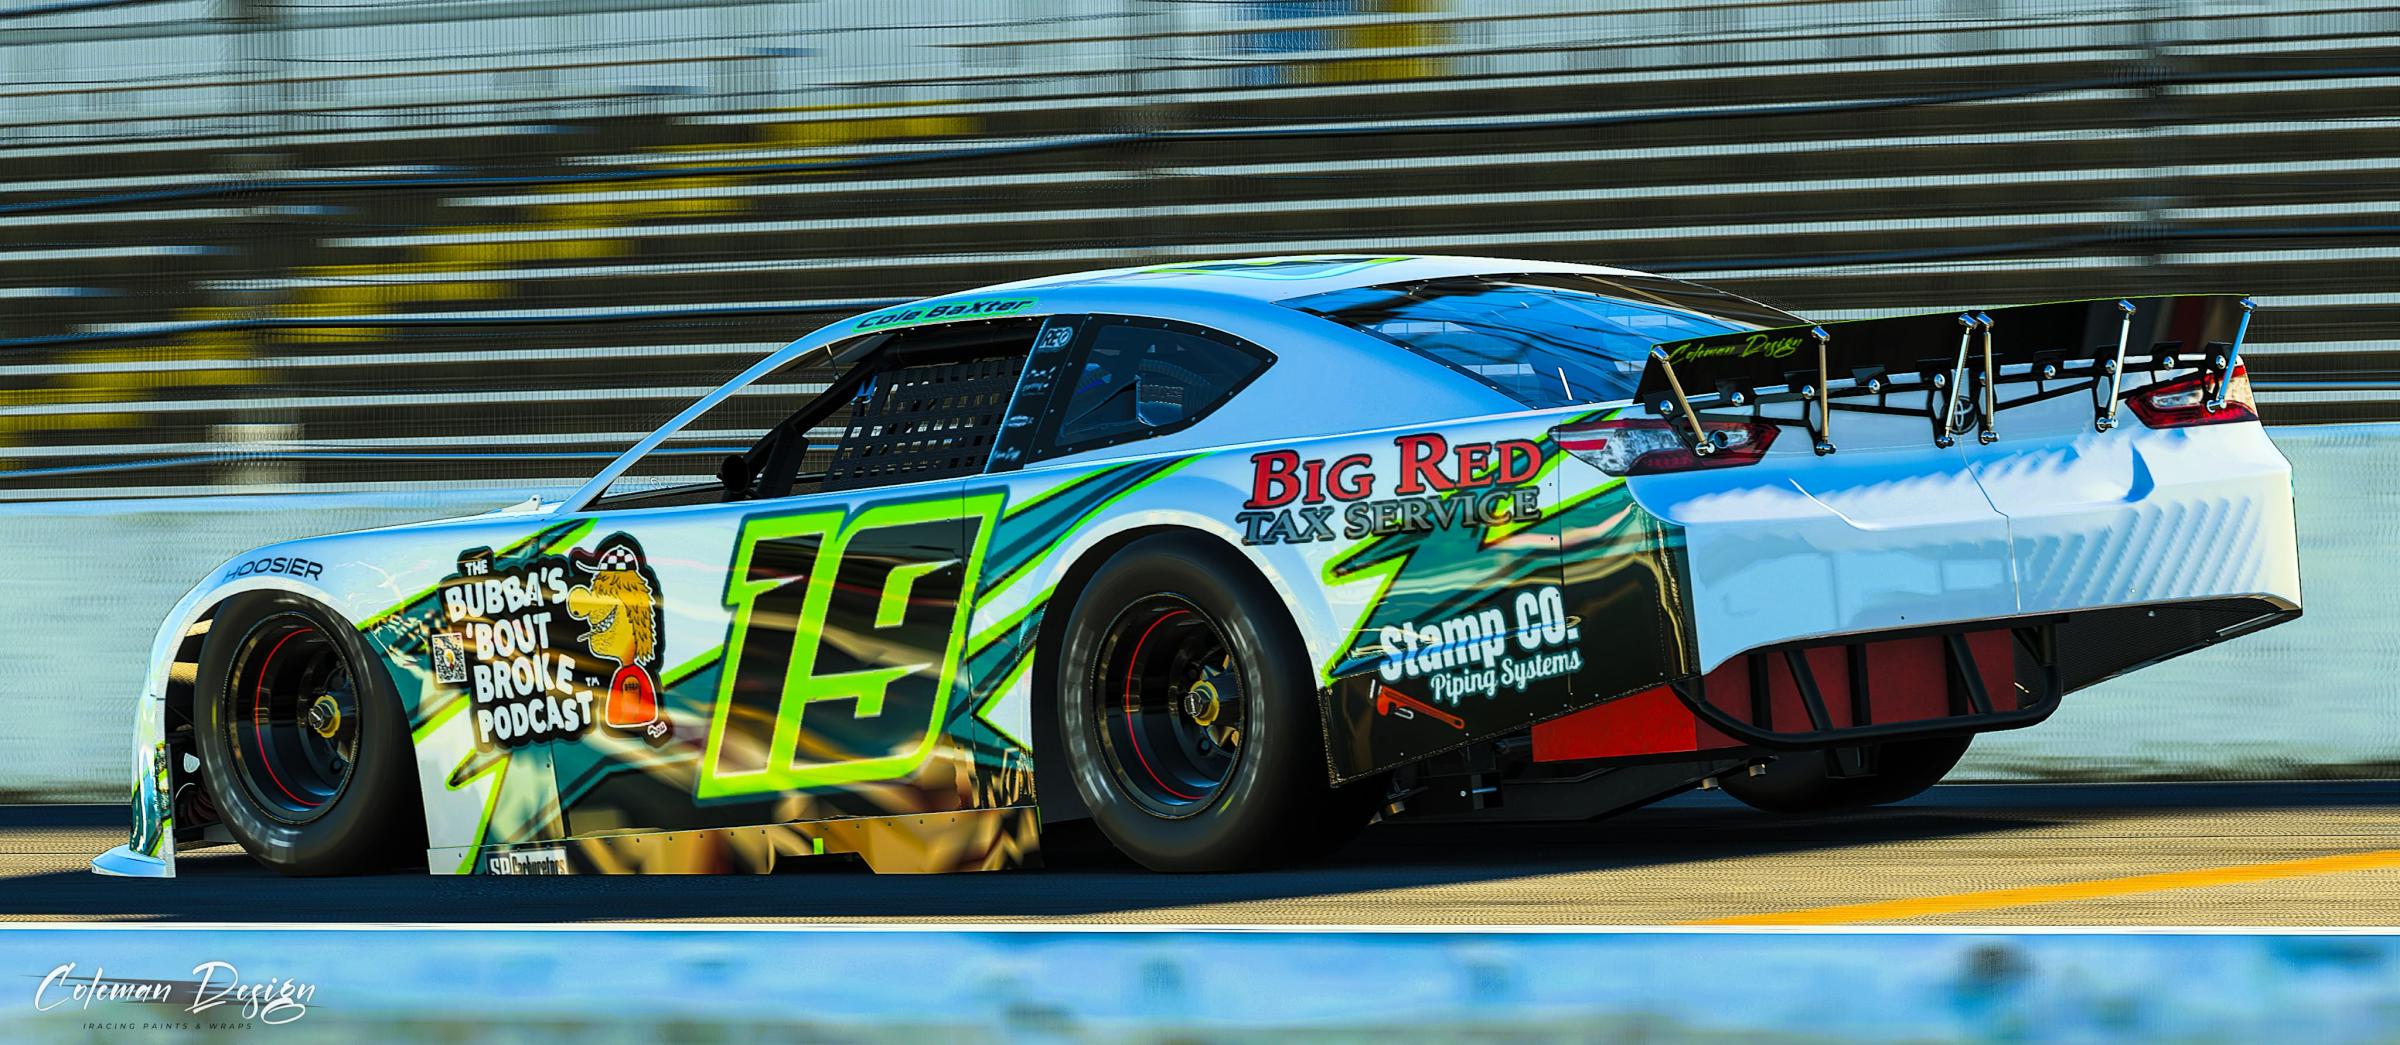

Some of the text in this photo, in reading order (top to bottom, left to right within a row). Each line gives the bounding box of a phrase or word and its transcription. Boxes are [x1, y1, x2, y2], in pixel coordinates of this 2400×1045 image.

[856, 310, 923, 329] Cole
[1739, 333, 1803, 358] Design
[1244, 432, 1543, 509] BIG RED
[1236, 486, 1541, 545] TAX SERVICE
[222, 557, 323, 581] HOOSIER
[465, 559, 488, 576] THE
[444, 566, 568, 622] BUBBA'S
[465, 612, 552, 660] 'BOUT
[695, 488, 1007, 802] 19
[1379, 608, 1506, 681] Stamp
[473, 653, 576, 704] BROKE
[1431, 650, 1582, 704] Piping Systems
[477, 690, 594, 742] PODCAST
